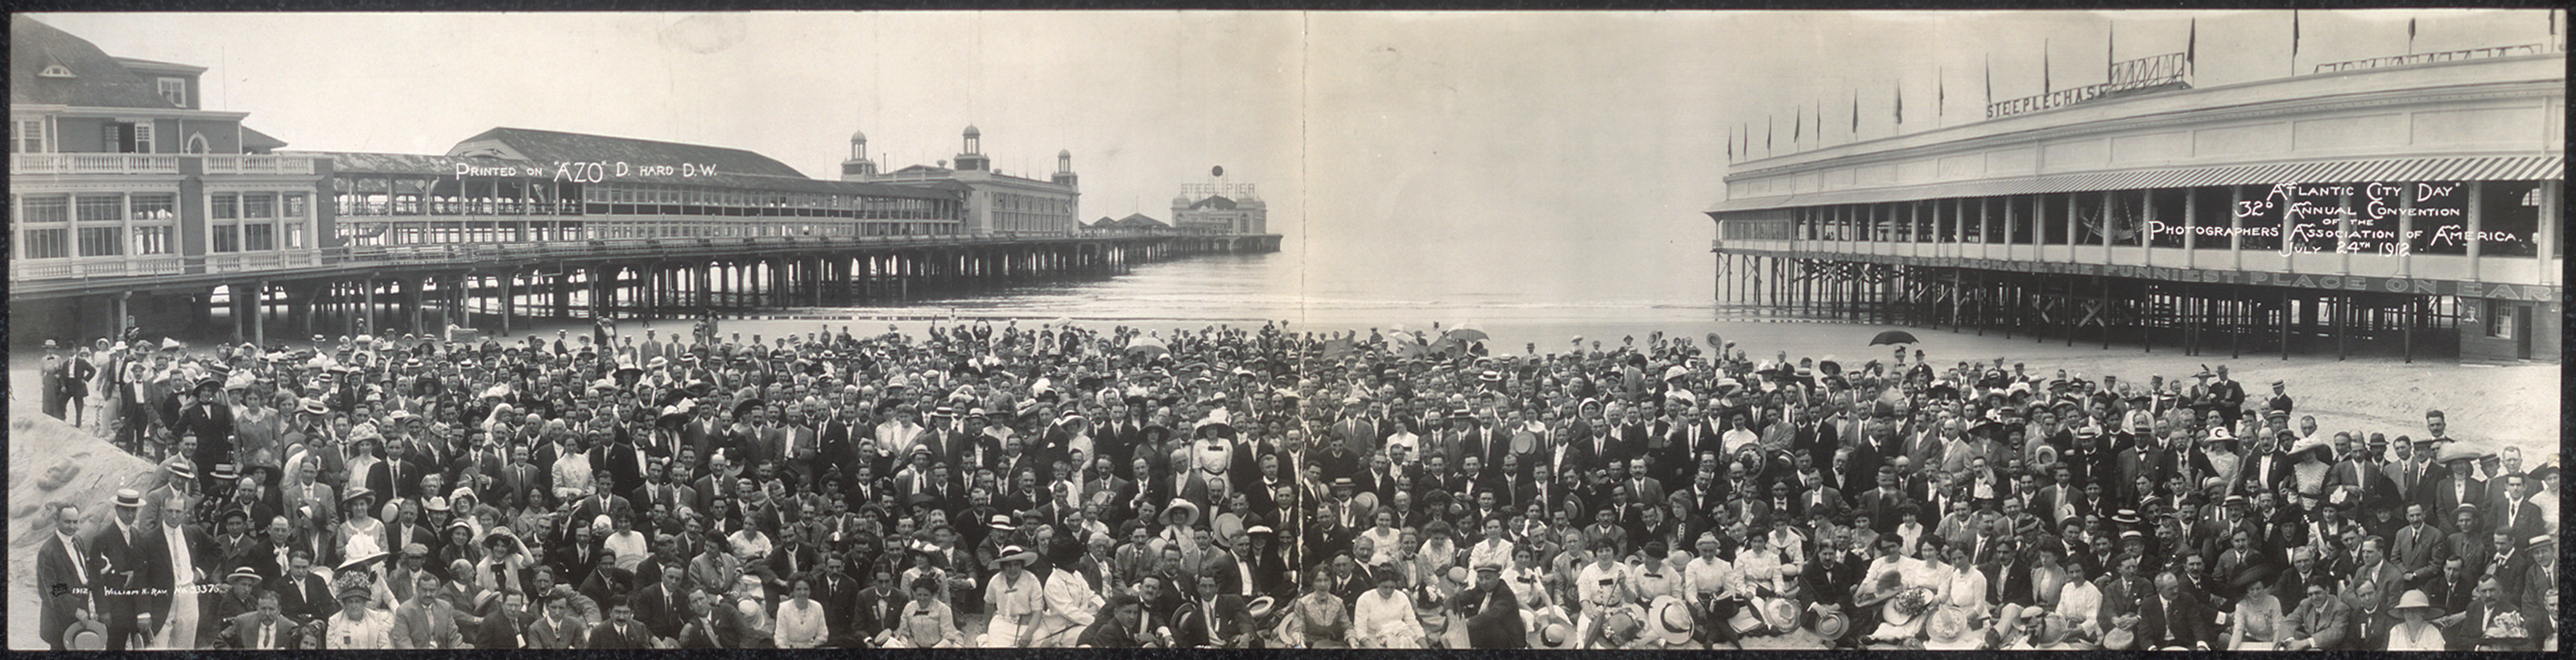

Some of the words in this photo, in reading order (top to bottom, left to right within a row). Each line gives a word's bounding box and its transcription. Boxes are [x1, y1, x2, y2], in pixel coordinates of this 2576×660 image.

[1987, 83, 2108, 118] STEEPLECHASE
[1181, 183, 1220, 194] STEEL
[1226, 183, 1256, 194] PIER
[2052, 262, 2094, 275] THE
[2103, 264, 2240, 283] FUNNIEST
[2249, 271, 2368, 291] PLACE
[2385, 278, 2438, 295] ON
